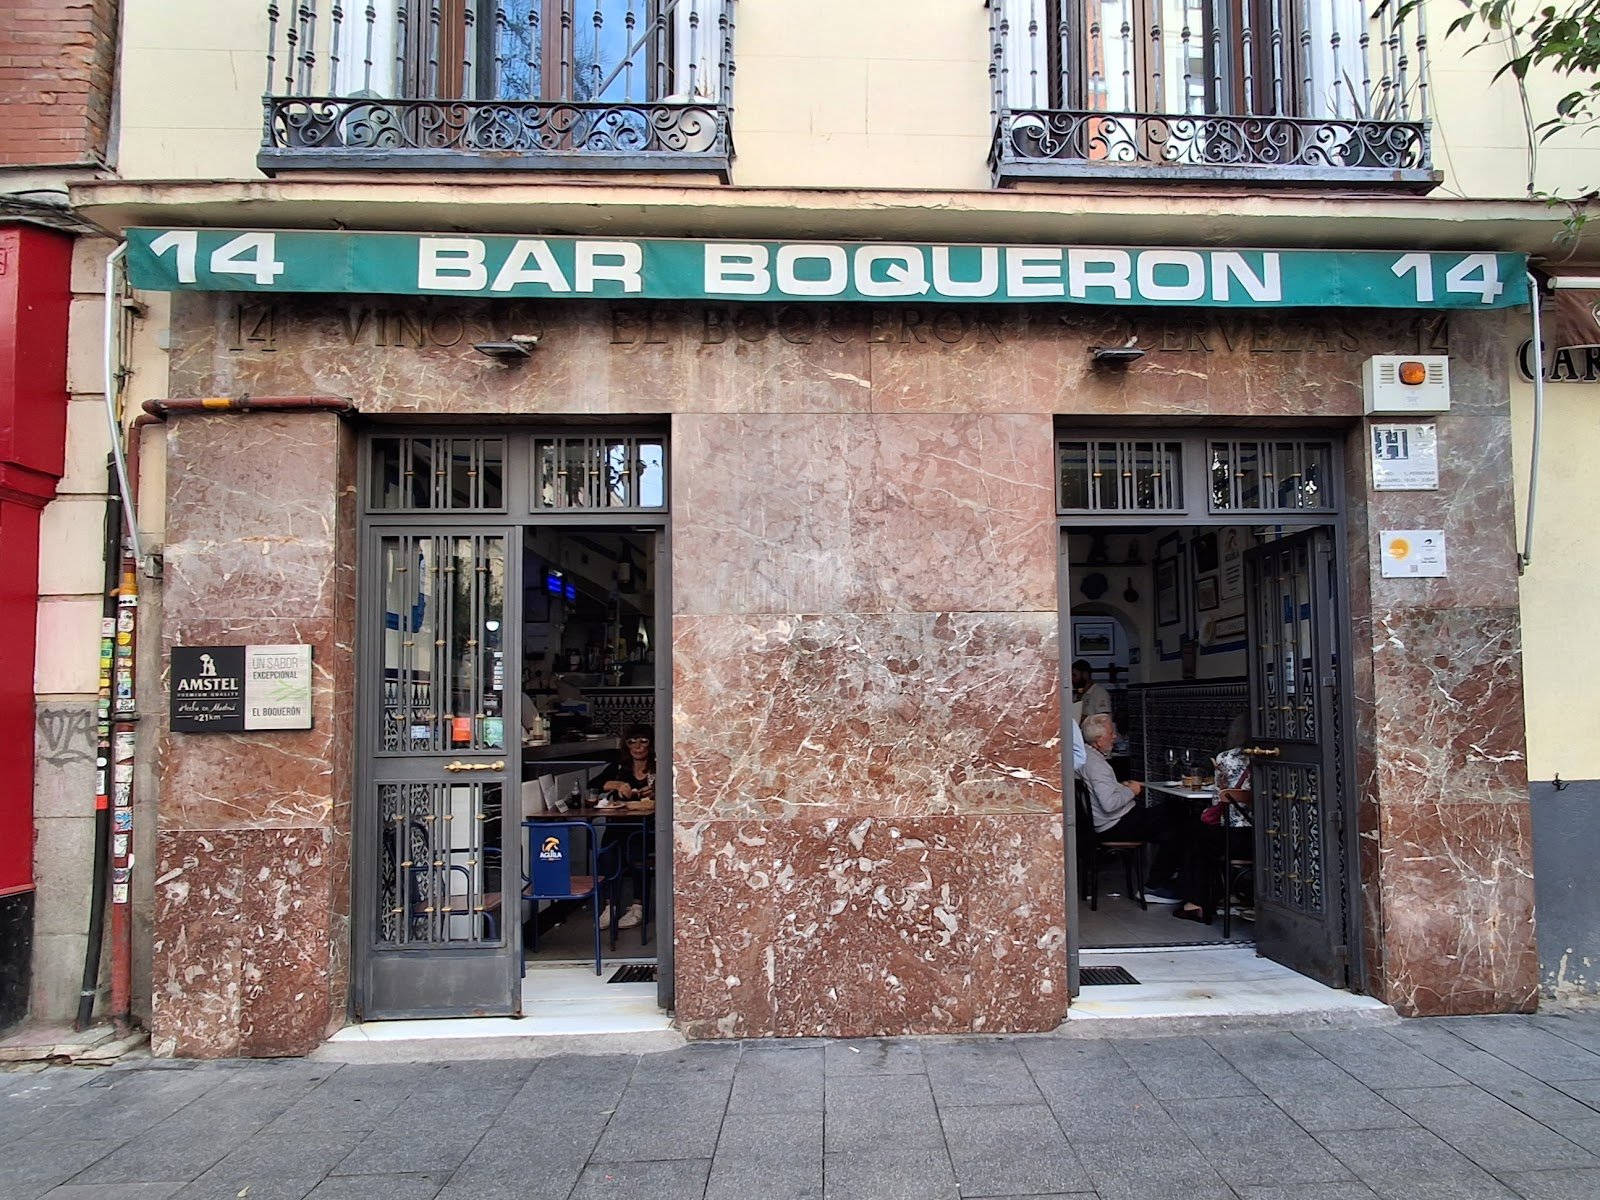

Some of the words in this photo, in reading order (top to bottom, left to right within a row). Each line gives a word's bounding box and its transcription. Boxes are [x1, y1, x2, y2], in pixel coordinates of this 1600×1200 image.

[149, 230, 284, 285] 14
[417, 236, 643, 293] BAR
[704, 243, 1282, 303] BOQUERON
[1390, 253, 1503, 304] 14
[229, 303, 277, 352] 14
[339, 308, 492, 348] VINOS
[252, 657, 265, 670] UN
[267, 656, 299, 669] SABOR
[252, 670, 298, 680] EXCEPCIONAL
[177, 677, 239, 692] AMSTEL
[252, 707, 261, 717] EL
[262, 706, 301, 717] BOQUERÓN
